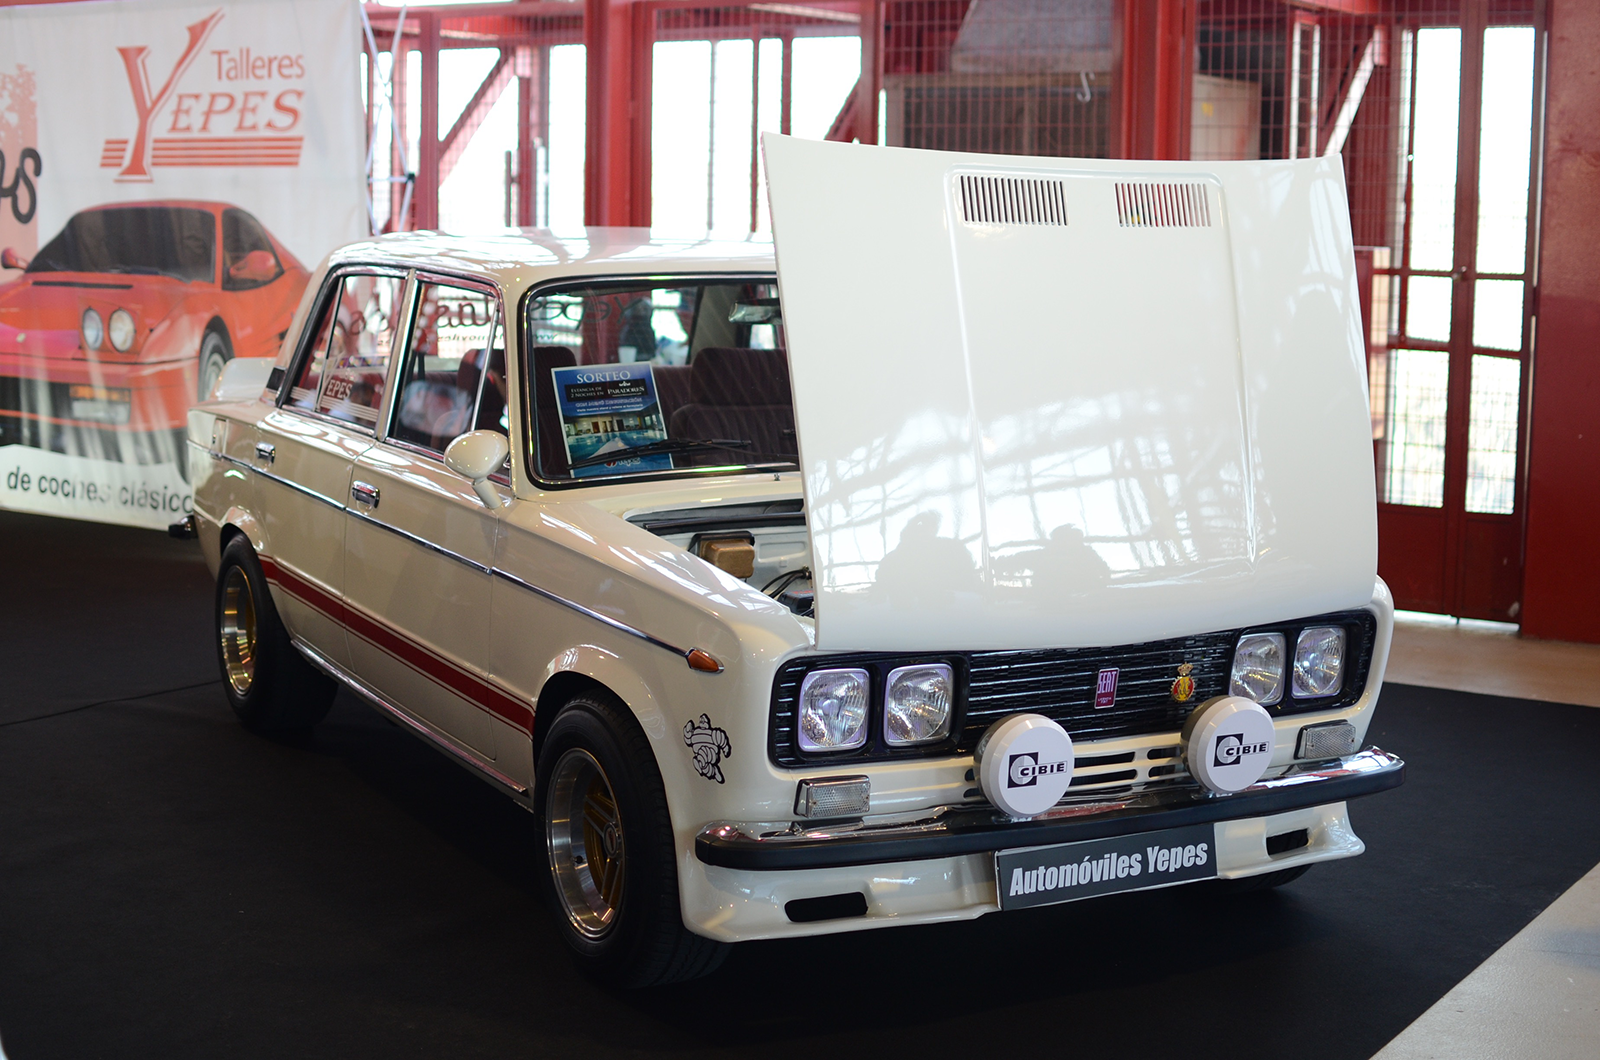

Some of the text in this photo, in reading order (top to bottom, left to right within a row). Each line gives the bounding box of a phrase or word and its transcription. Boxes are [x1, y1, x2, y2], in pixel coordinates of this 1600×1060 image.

[211, 48, 305, 82] Talleres
[577, 370, 631, 384] SORTEO
[7, 465, 31, 491] de
[1097, 671, 1117, 694] SEAT
[1009, 843, 1208, 896] Automóviles Yepes
